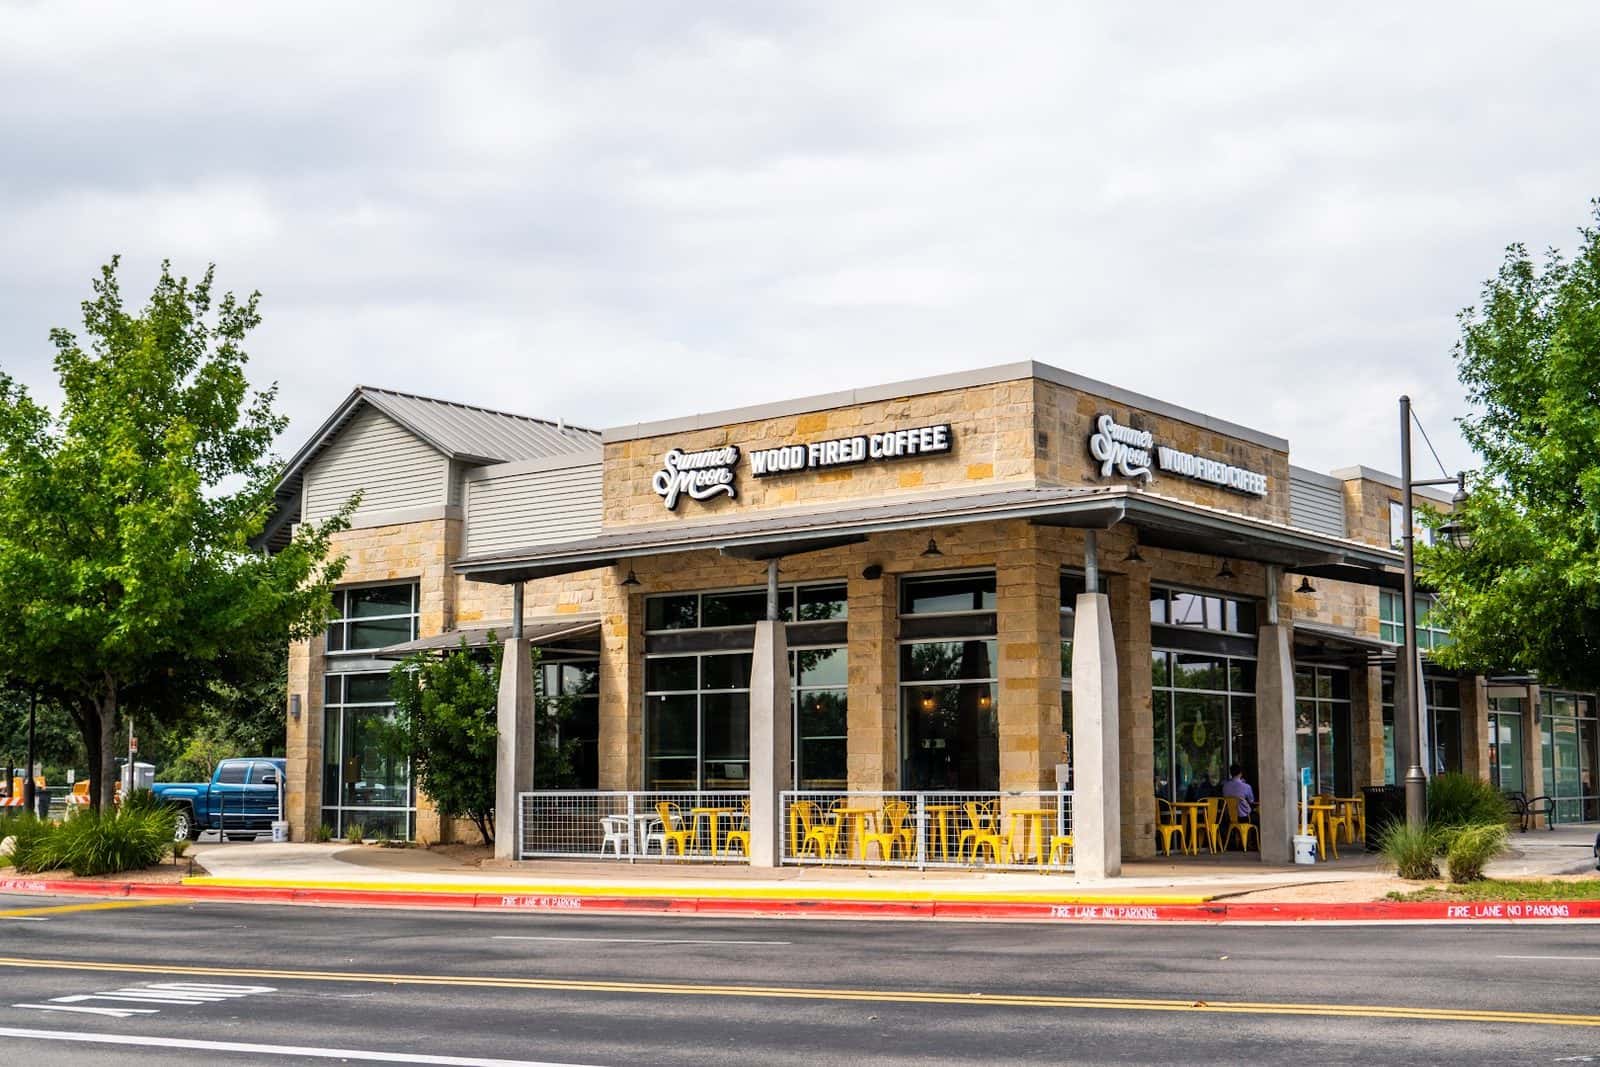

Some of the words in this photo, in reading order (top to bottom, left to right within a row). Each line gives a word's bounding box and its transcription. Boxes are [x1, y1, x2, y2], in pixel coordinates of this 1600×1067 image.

[750, 446, 806, 475] WOOD
[808, 436, 867, 467] FIRED
[869, 424, 948, 457] COFFEE
[1092, 415, 1153, 456] Summer
[653, 446, 738, 484] Summer
[1101, 441, 1152, 482] Moon
[1158, 446, 1195, 476] WOOD
[1195, 456, 1228, 486] FIRED
[1227, 466, 1268, 496] COFFEE
[662, 467, 735, 508] Moon
[1050, 904, 1071, 918] FIRE
[1074, 905, 1098, 918] LANE
[1102, 906, 1116, 919] NO
[1119, 906, 1158, 920] PARKING
[1447, 905, 1471, 917] FIRE
[1475, 905, 1503, 917] LANE
[1507, 905, 1521, 917] NO
[1525, 904, 1569, 917] PARKING
